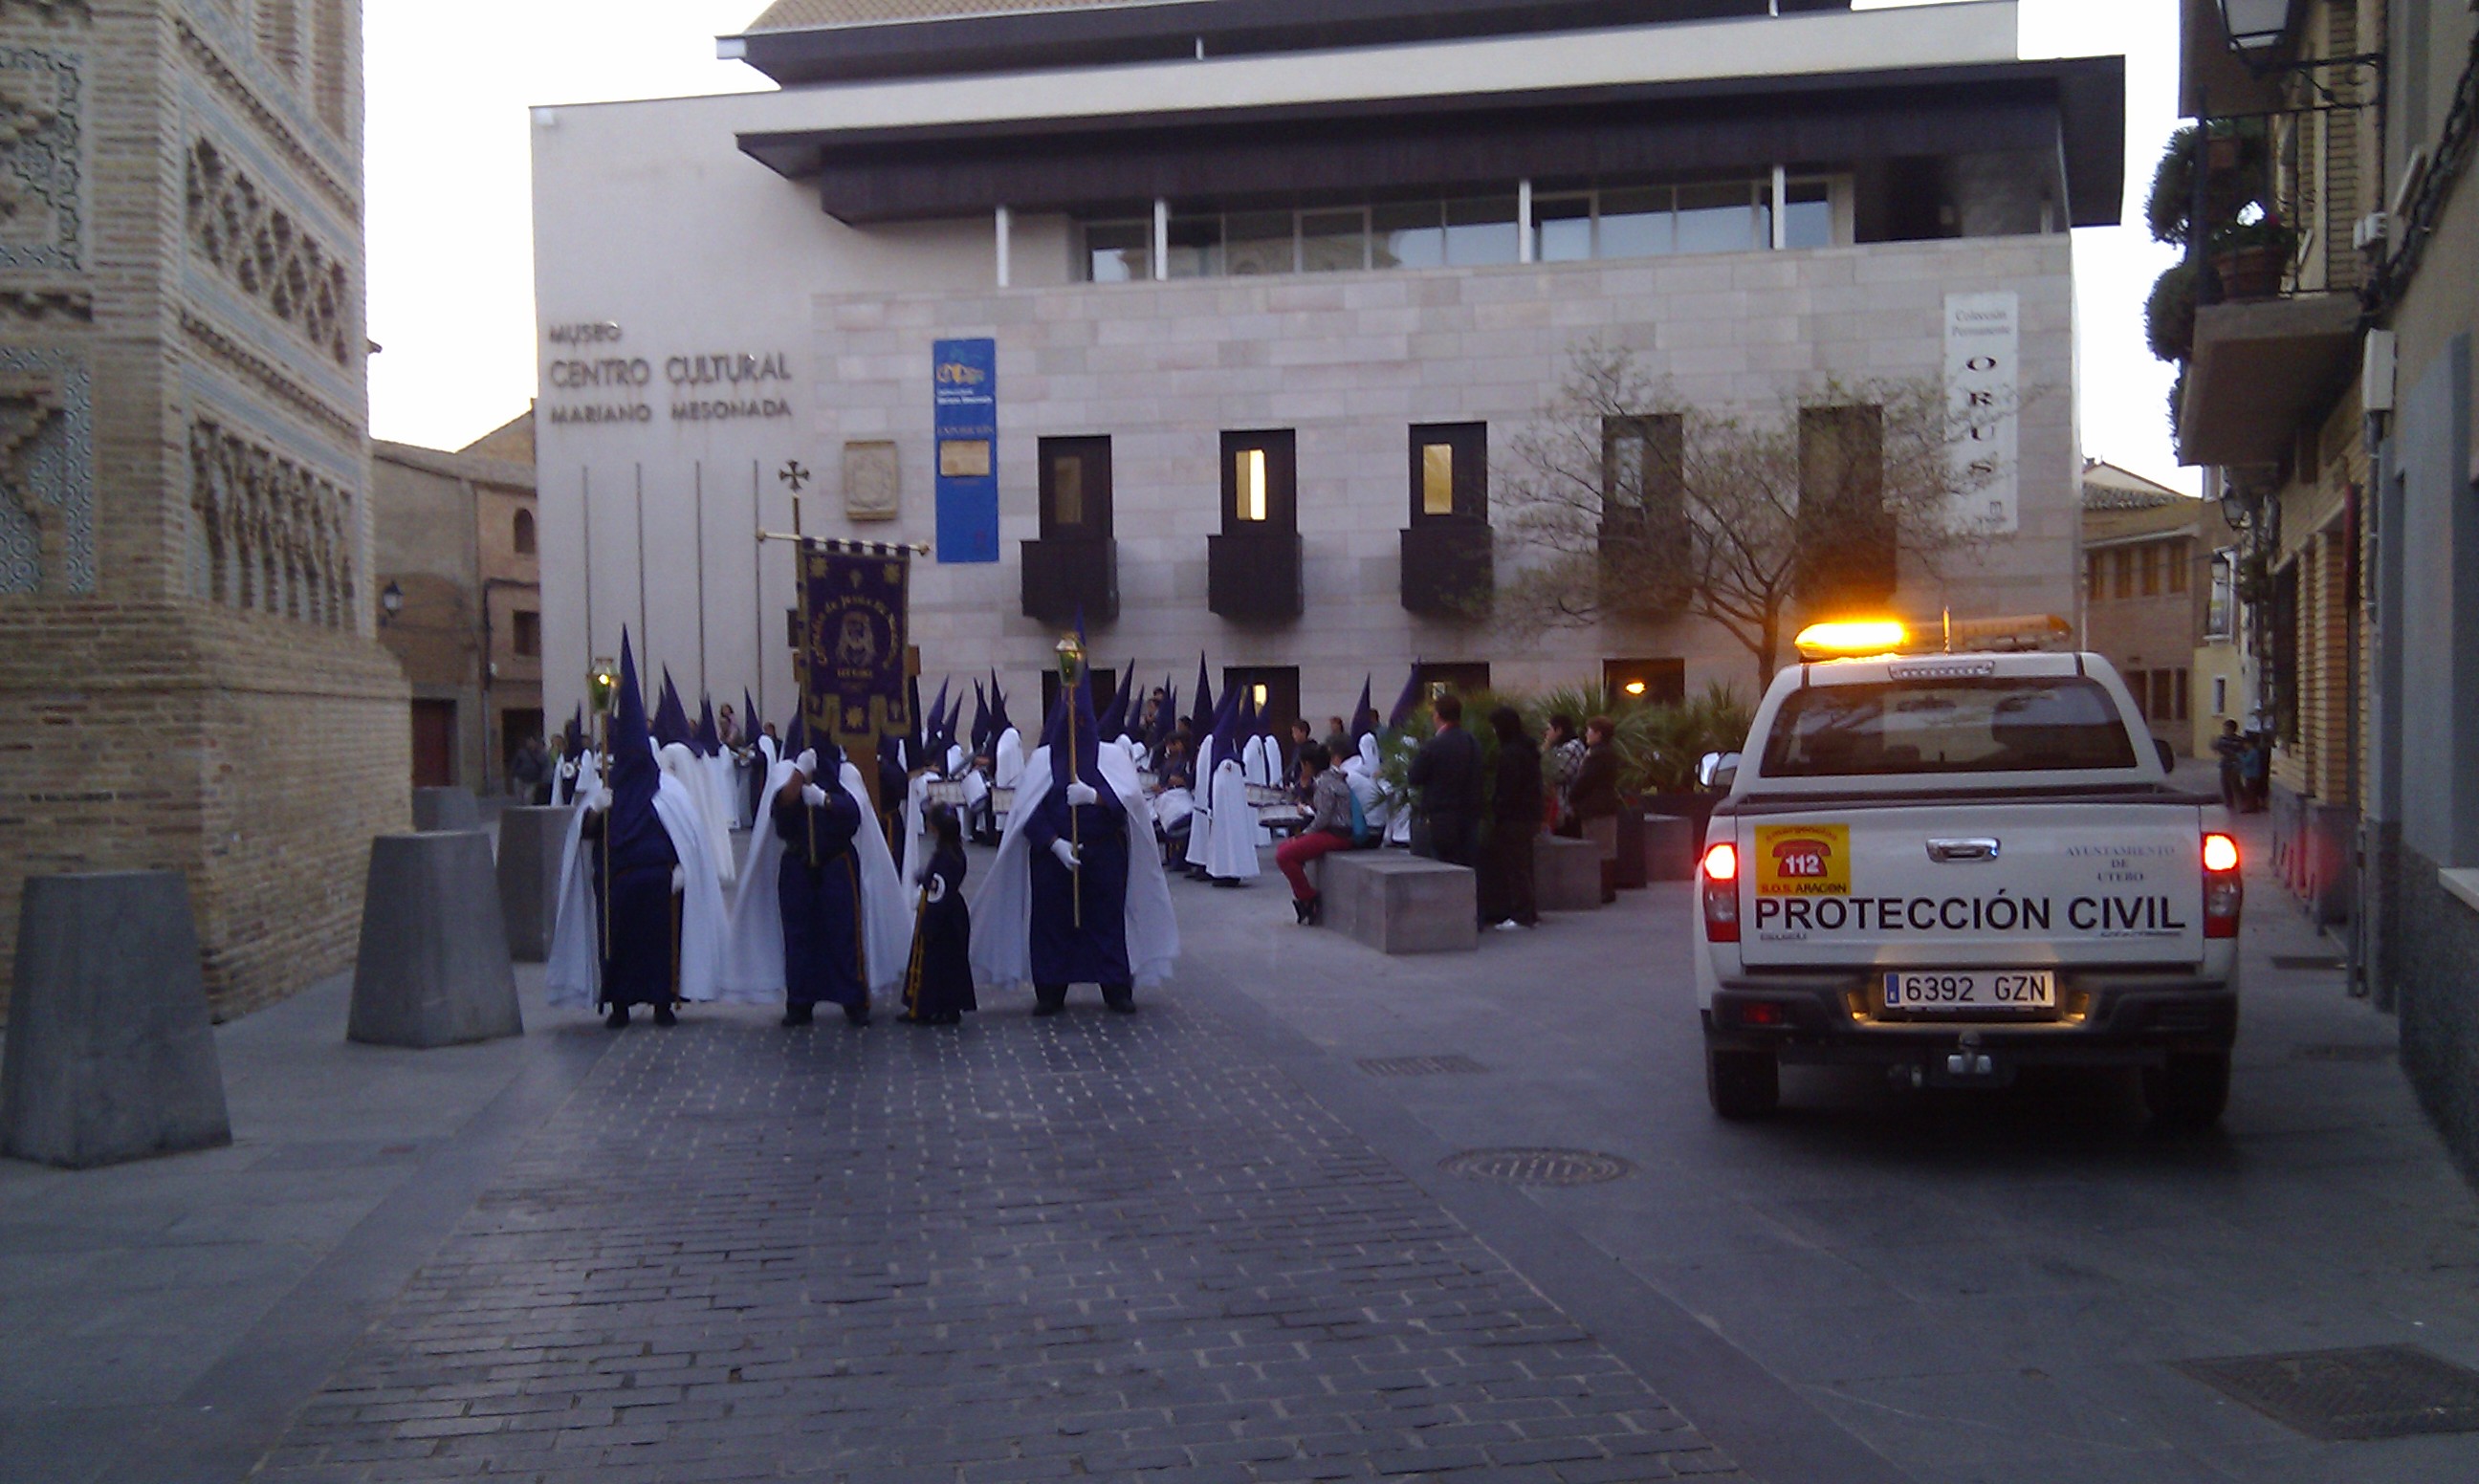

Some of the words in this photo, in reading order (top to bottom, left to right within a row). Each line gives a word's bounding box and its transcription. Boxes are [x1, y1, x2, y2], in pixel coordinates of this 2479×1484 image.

[549, 321, 622, 343] MUSEO
[550, 358, 650, 387] CENTRO
[667, 353, 793, 384] CULTURAL
[551, 404, 651, 424] MARIANO
[671, 398, 792, 421] MESONADA
[1785, 854, 1820, 874] 112
[1755, 887, 2050, 930] PROTECCIÓN
[2068, 896, 2186, 930] CIVIL
[1906, 975, 1974, 1002] 6392
[1995, 975, 2046, 1002] GZN
